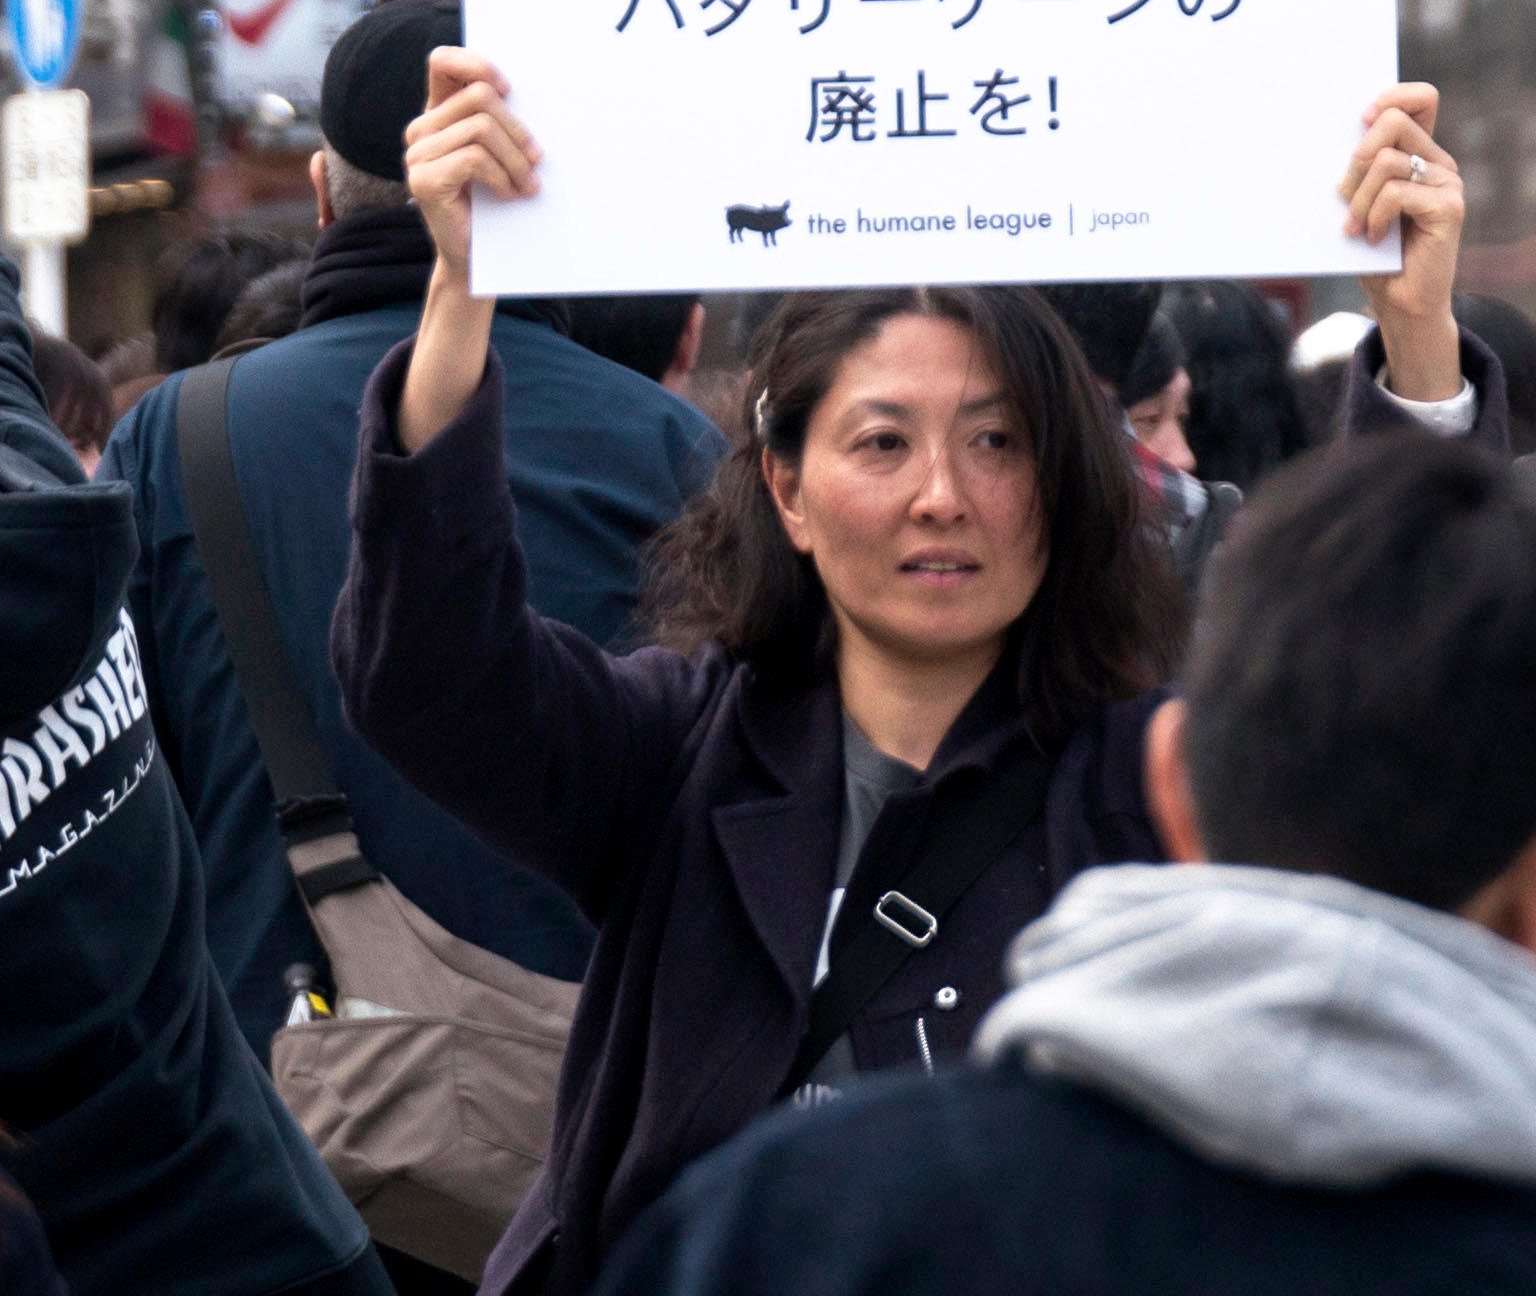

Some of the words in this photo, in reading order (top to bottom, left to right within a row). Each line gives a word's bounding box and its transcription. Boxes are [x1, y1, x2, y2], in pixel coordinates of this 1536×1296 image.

[804, 68, 1061, 144] 廃止を!
[807, 213, 847, 234] the
[857, 208, 956, 233] humane
[967, 205, 1052, 237] league
[1088, 207, 1150, 232] japan
